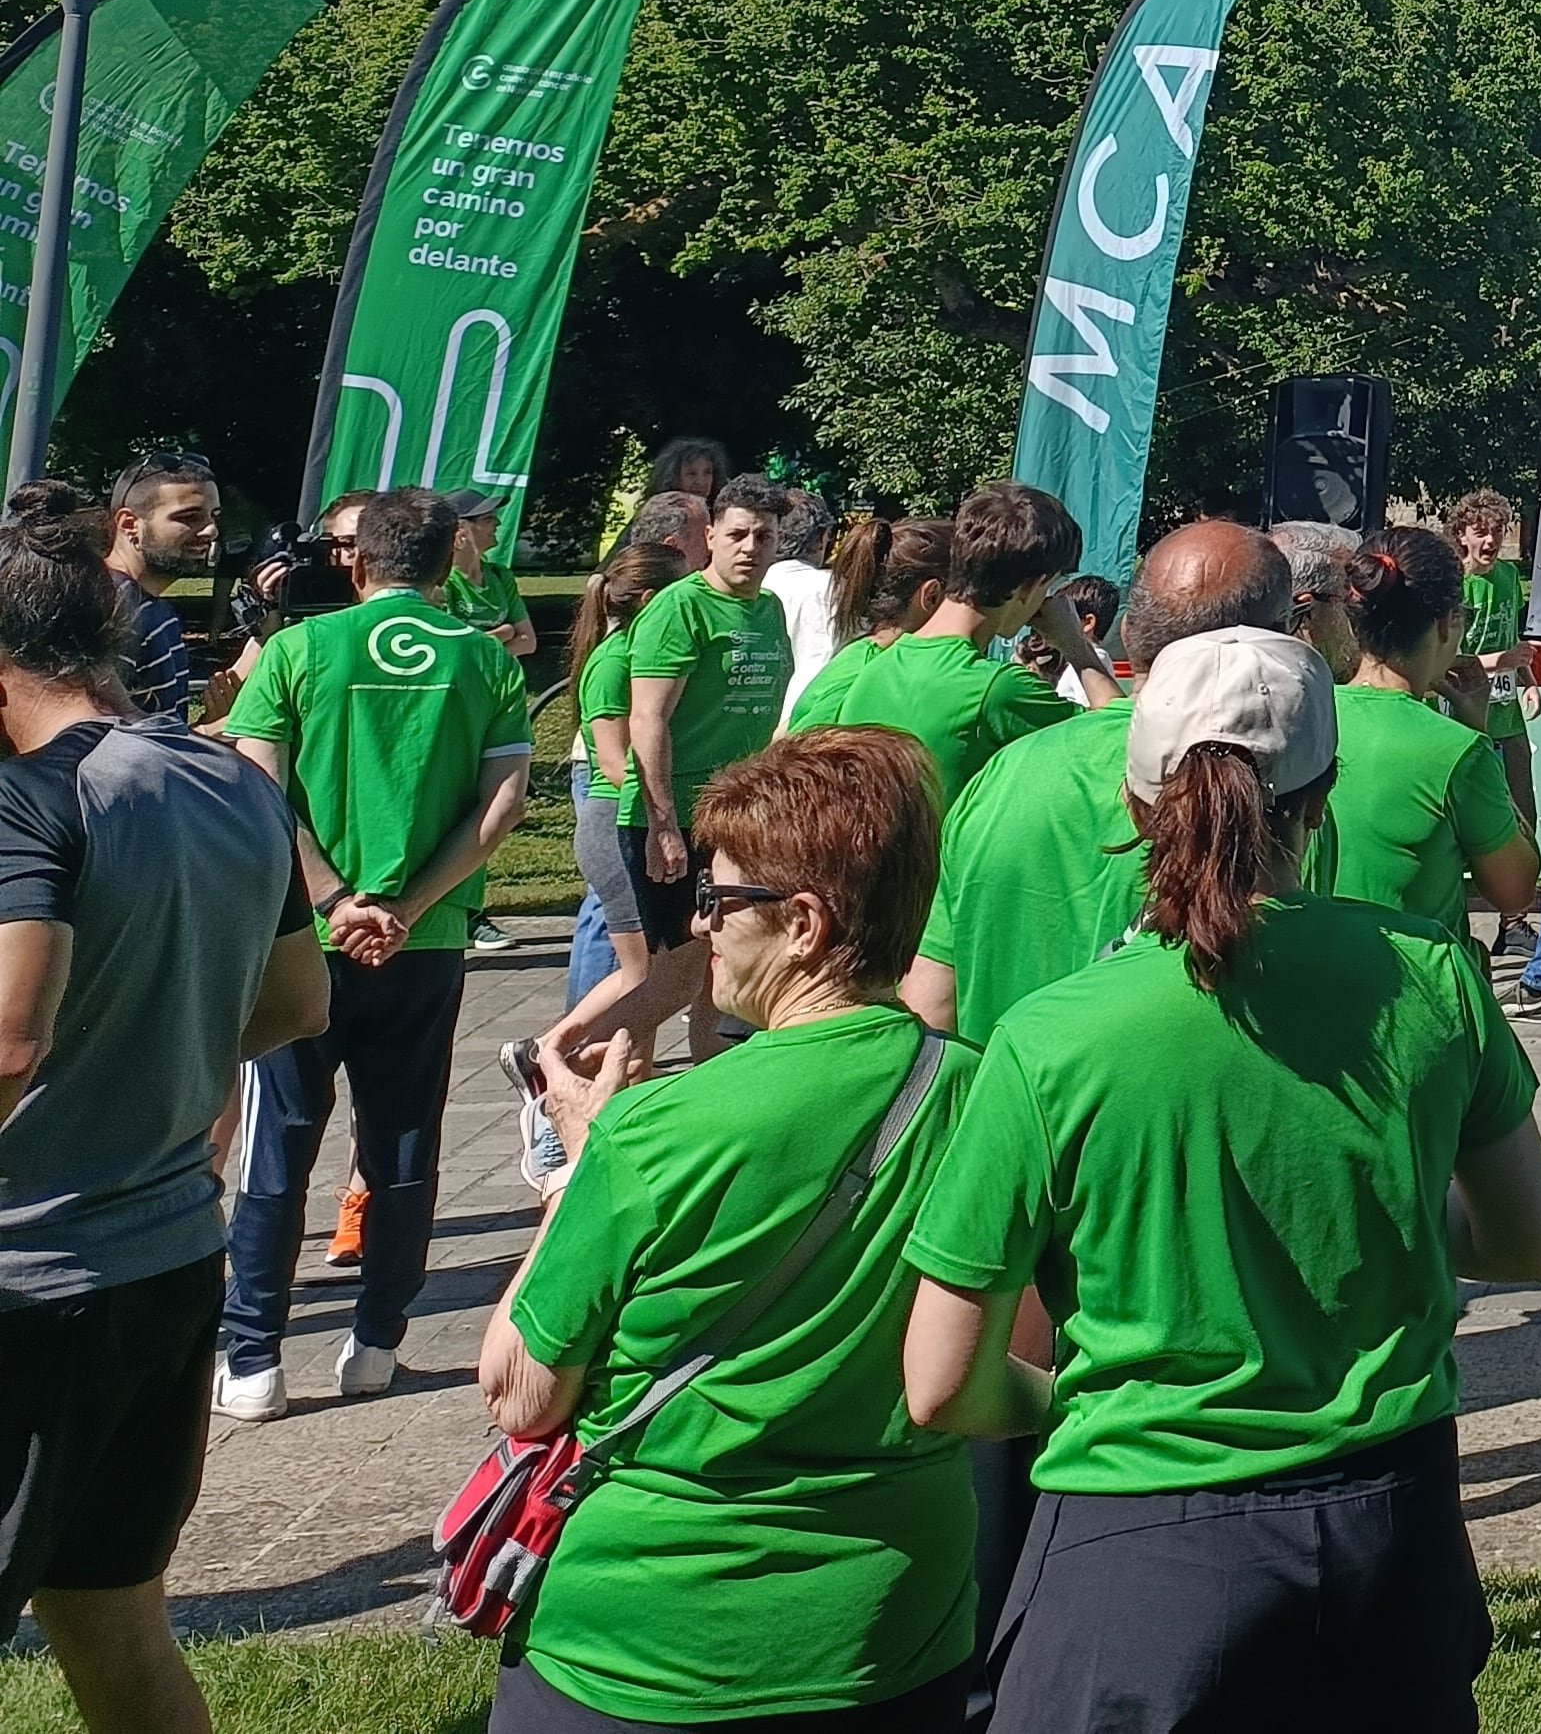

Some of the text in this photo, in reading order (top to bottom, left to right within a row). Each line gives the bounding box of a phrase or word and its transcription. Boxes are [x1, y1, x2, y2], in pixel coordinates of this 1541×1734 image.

[443, 123, 565, 162] Tenemos
[432, 157, 535, 189] un gran
[423, 187, 525, 217] camino
[414, 216, 464, 239] por
[1028, 44, 1220, 434] MCA
[408, 243, 518, 278] delante
